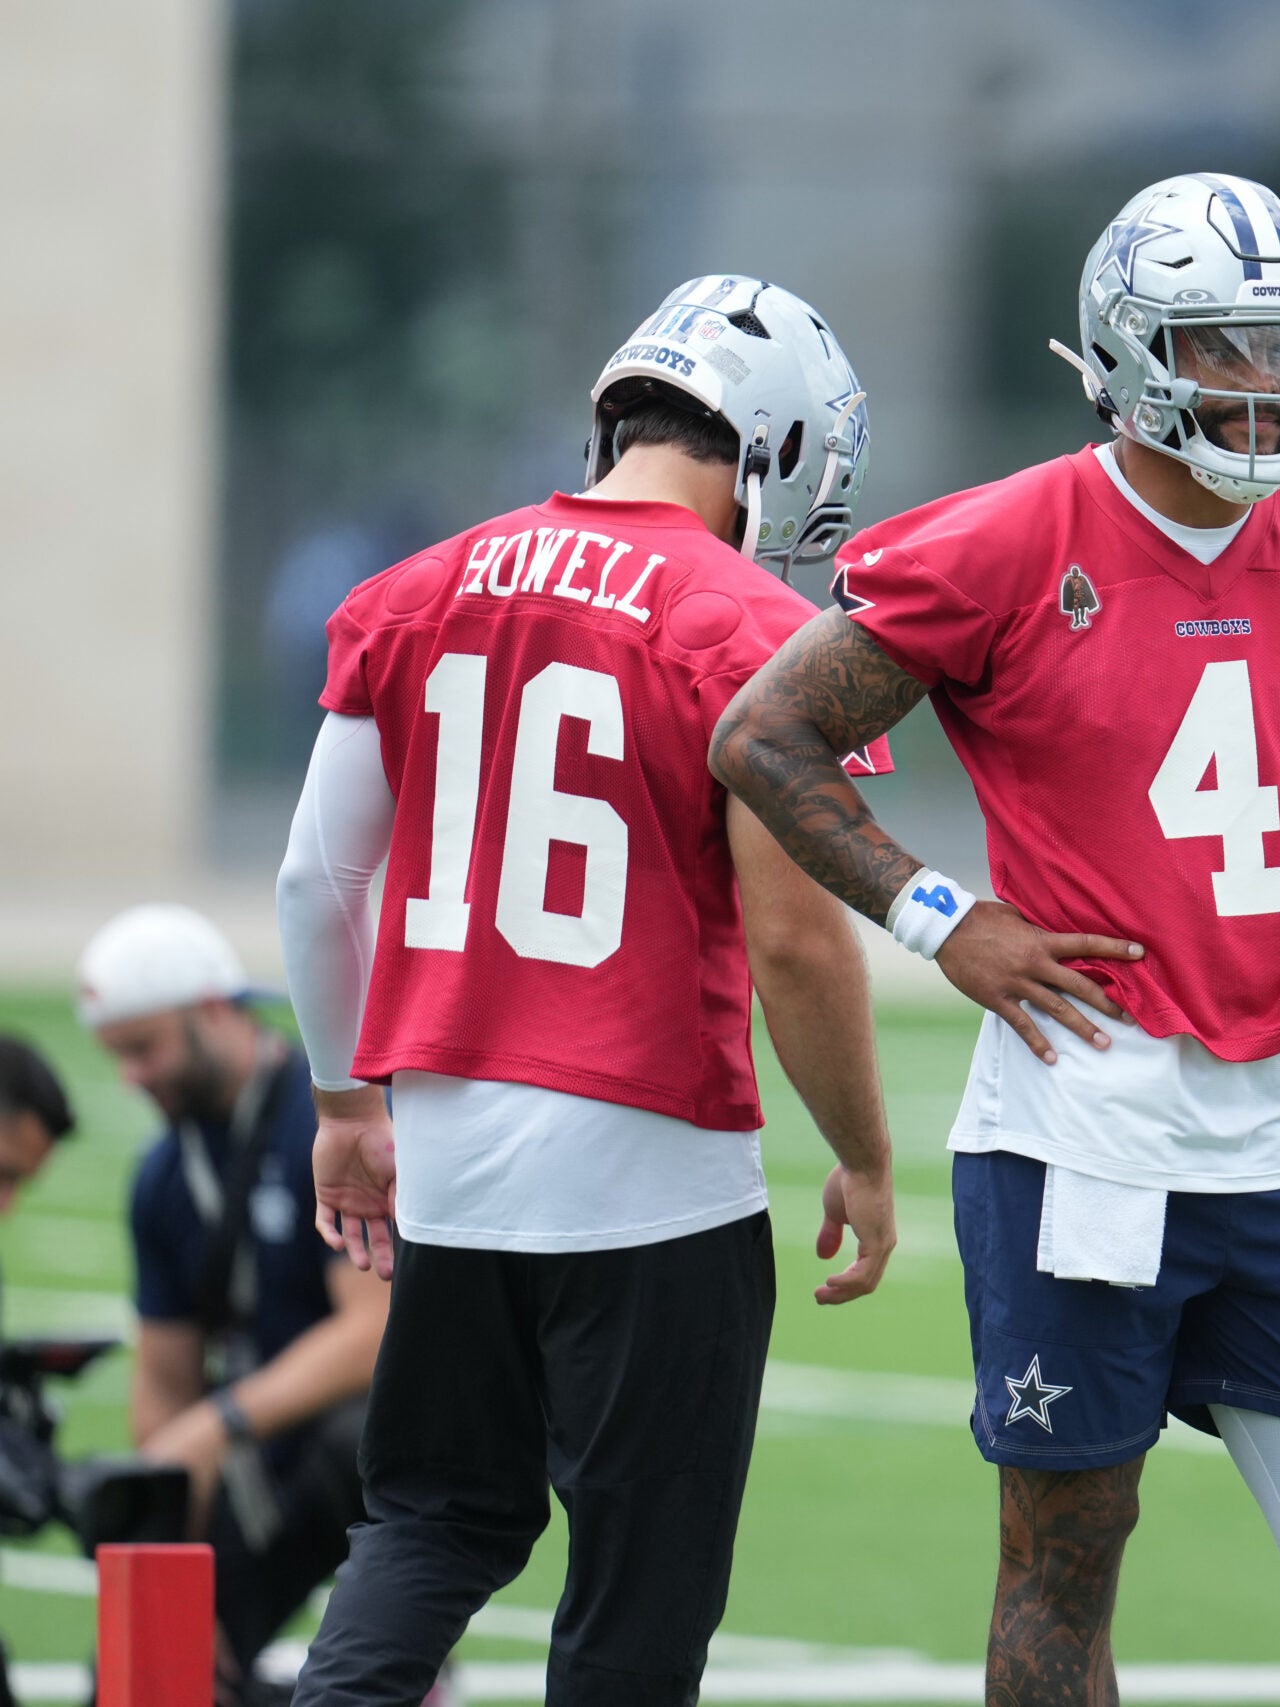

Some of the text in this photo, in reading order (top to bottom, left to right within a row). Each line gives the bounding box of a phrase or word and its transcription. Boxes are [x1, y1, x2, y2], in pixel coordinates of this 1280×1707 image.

[701, 326, 719, 340] NFL
[608, 343, 697, 377] COWBOYS
[456, 527, 665, 624] HOWELL
[1175, 618, 1252, 637] COWBOYS
[404, 652, 629, 969] 16
[911, 885, 959, 918] 4
